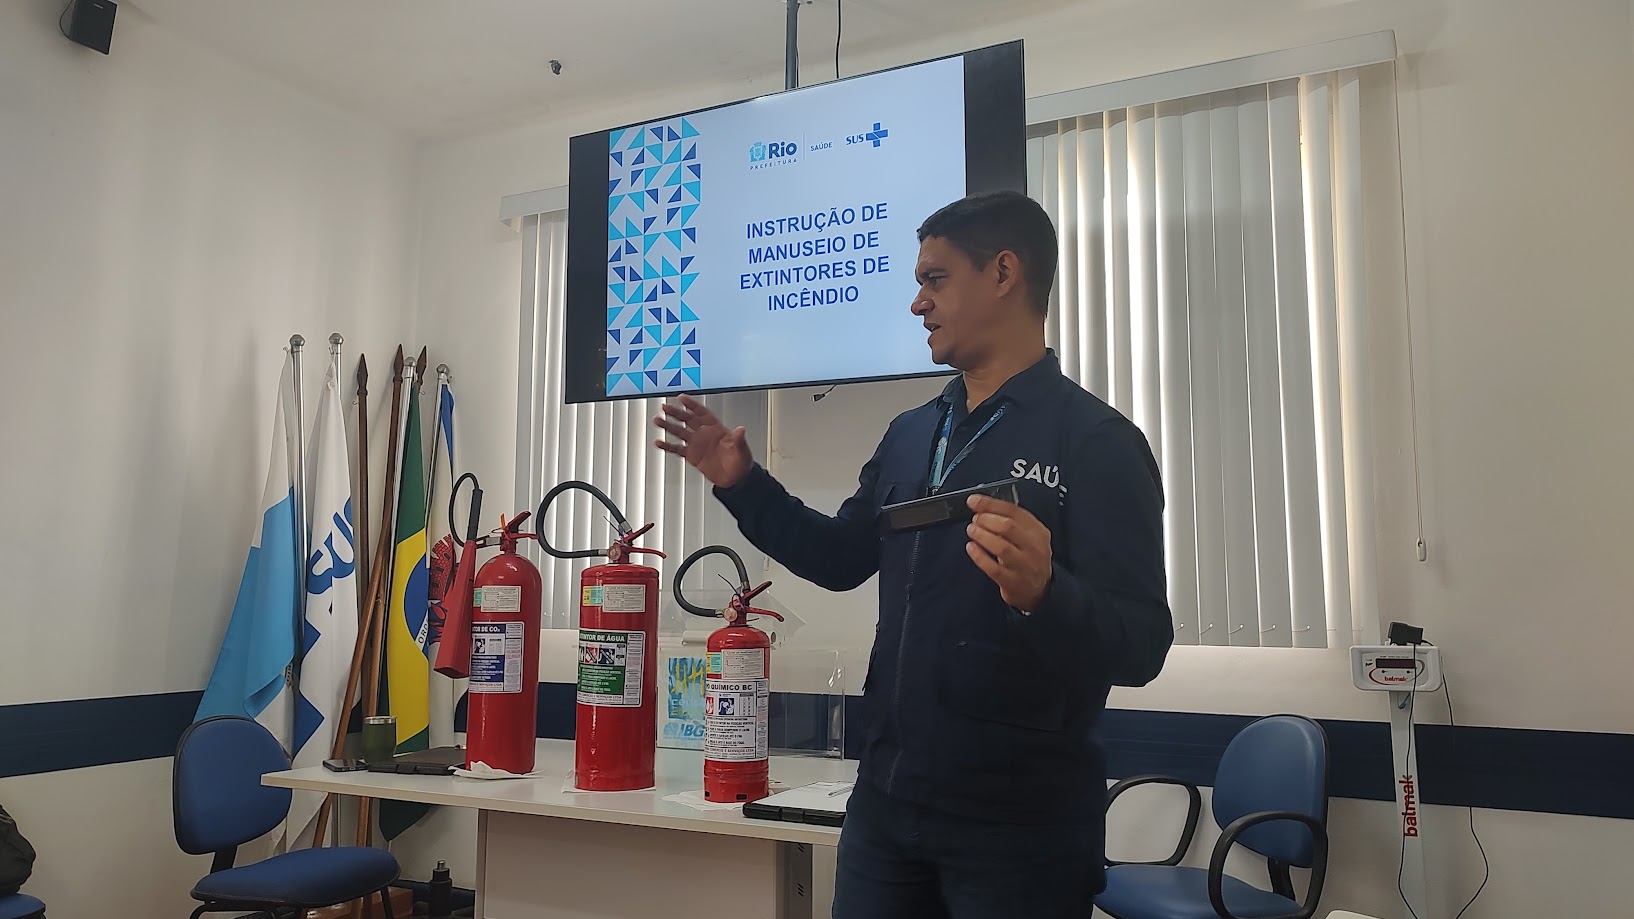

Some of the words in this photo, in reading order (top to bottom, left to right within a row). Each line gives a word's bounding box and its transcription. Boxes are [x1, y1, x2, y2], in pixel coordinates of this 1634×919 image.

[810, 141, 833, 152] SAÚDE
[846, 133, 864, 146] SUS
[768, 141, 798, 159] Rio
[749, 158, 798, 171] PREFEITURA
[746, 207, 856, 239] INSTRUÇÃO
[861, 202, 888, 222] DE
[748, 236, 846, 264] MANUSEIO
[853, 231, 879, 250] DE
[740, 260, 857, 290] EXTINTORES
[863, 255, 890, 275] DE
[768, 285, 859, 311] INCÊNDIO
[1010, 458, 1068, 503] SAÚ
[606, 633, 625, 642] ÁGUA
[711, 683, 740, 691] QUÍMICO
[681, 723, 706, 738] IBG
[1398, 774, 1418, 838] balmak
